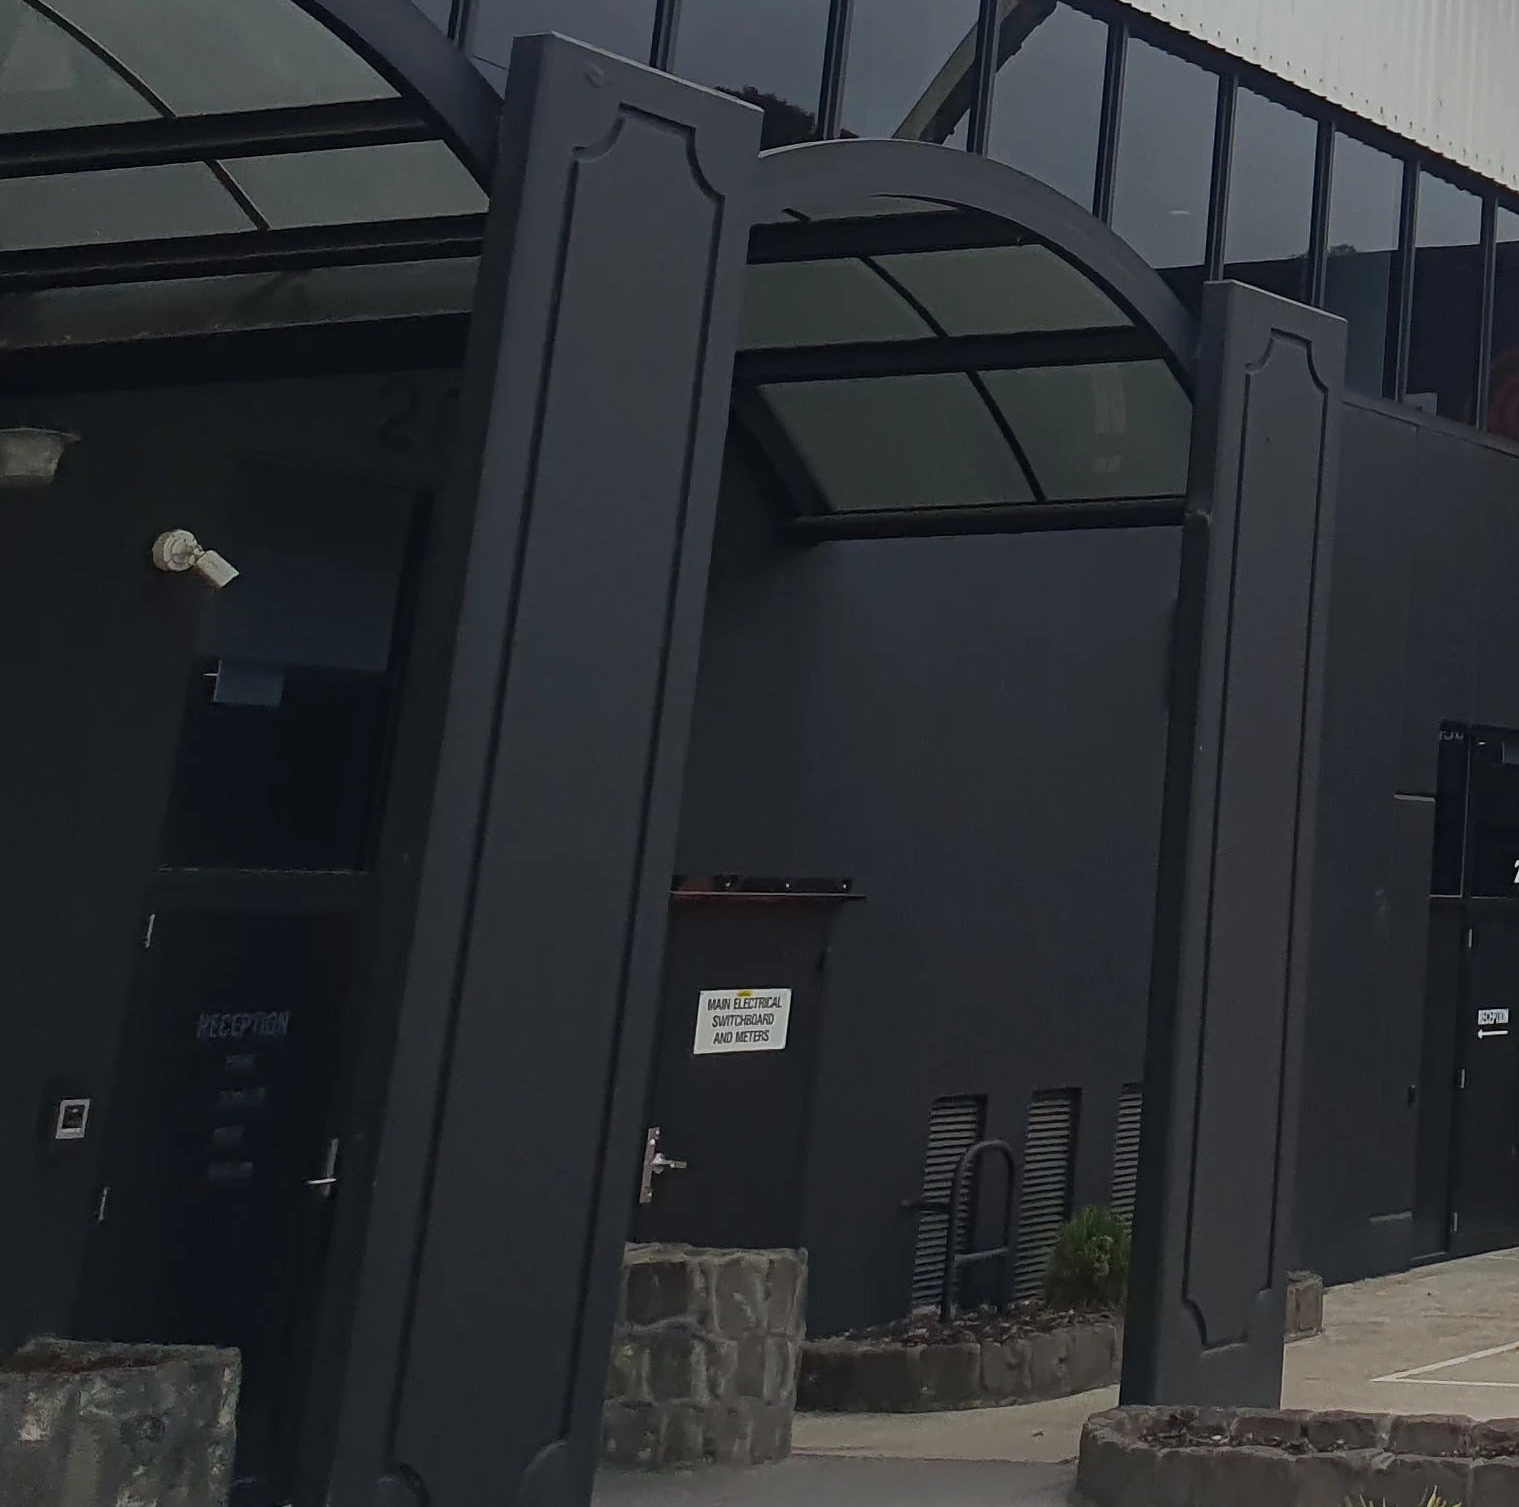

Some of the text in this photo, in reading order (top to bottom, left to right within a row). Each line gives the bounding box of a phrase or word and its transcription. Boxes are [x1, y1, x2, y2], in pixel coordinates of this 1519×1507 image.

[708, 996, 782, 1011] MAIN ELECTRICAL
[712, 1013, 774, 1028] SWITCHBOARD
[713, 1029, 769, 1045] AND METERS
